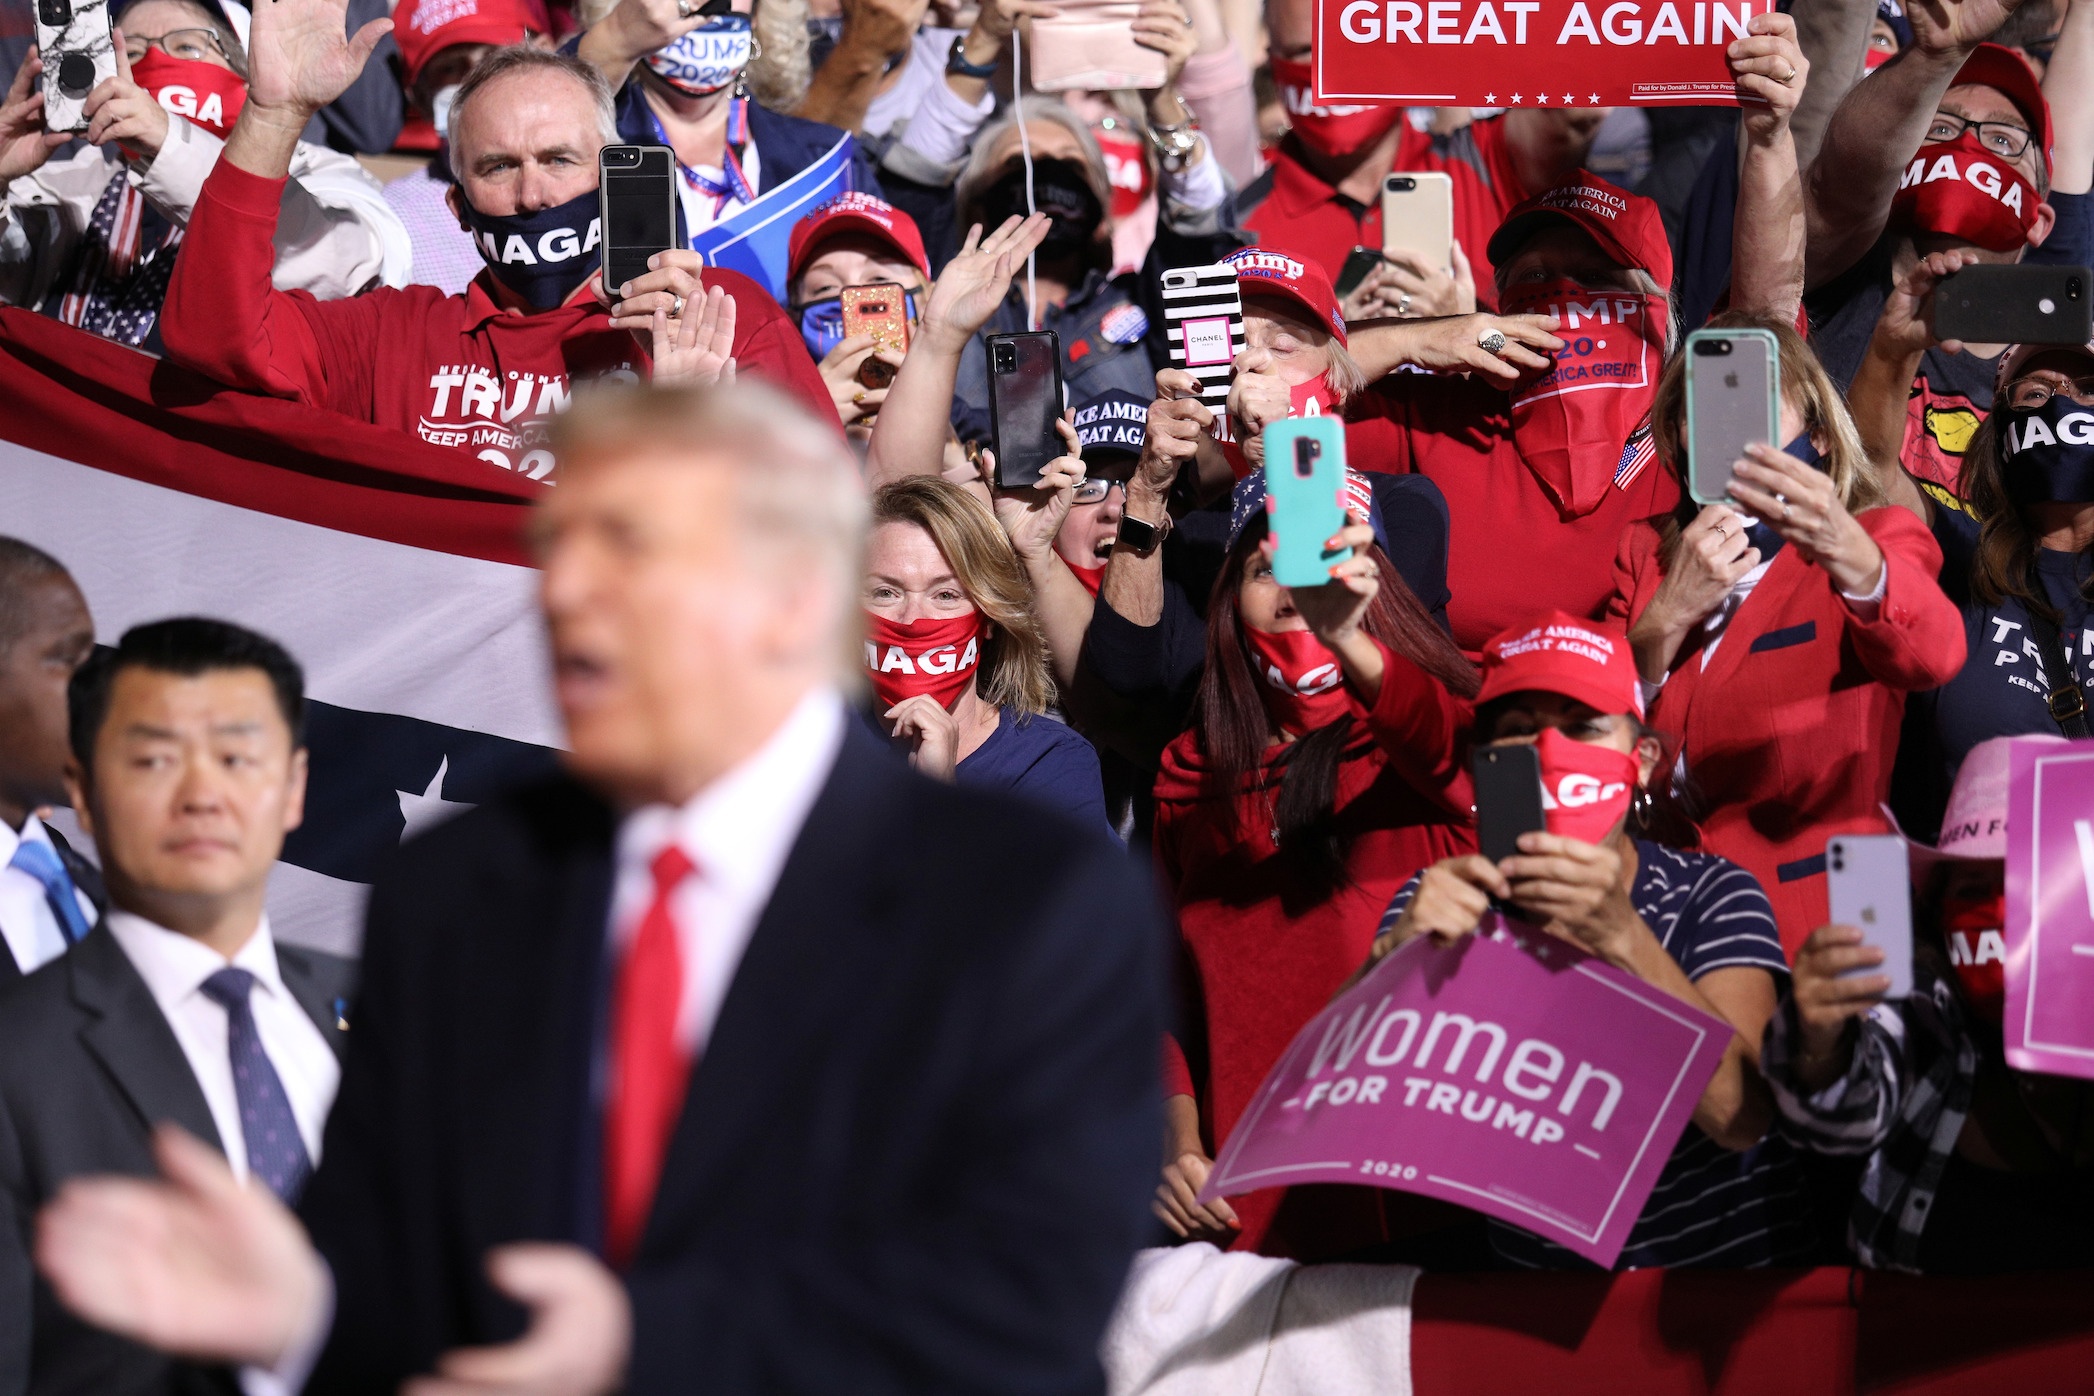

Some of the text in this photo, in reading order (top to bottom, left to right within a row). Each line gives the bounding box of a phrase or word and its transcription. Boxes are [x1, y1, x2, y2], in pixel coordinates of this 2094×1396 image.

[1340, 0, 1751, 46] GREAT AGAIN
[664, 36, 747, 60] RUMP
[665, 59, 730, 84] 2020
[144, 84, 223, 128] GA
[1102, 152, 1142, 193] GA
[1560, 186, 1628, 211] AMERICA
[1900, 154, 2023, 220] MAGA
[1570, 200, 1618, 221] AGAIN
[472, 216, 601, 266] MAGA
[1190, 334, 1224, 343] CHANEL
[502, 369, 573, 386] OUNTY
[1074, 404, 1099, 428] KE
[417, 422, 468, 448] KEEP
[1500, 639, 1608, 666] GREAT AGAIN
[1544, 624, 1615, 655] AMERICA
[2008, 674, 2041, 693] KEEP
[1304, 992, 1624, 1132] Women
[1303, 1075, 1565, 1145] FOR TRUMP
[1359, 1159, 1419, 1181] 2020
